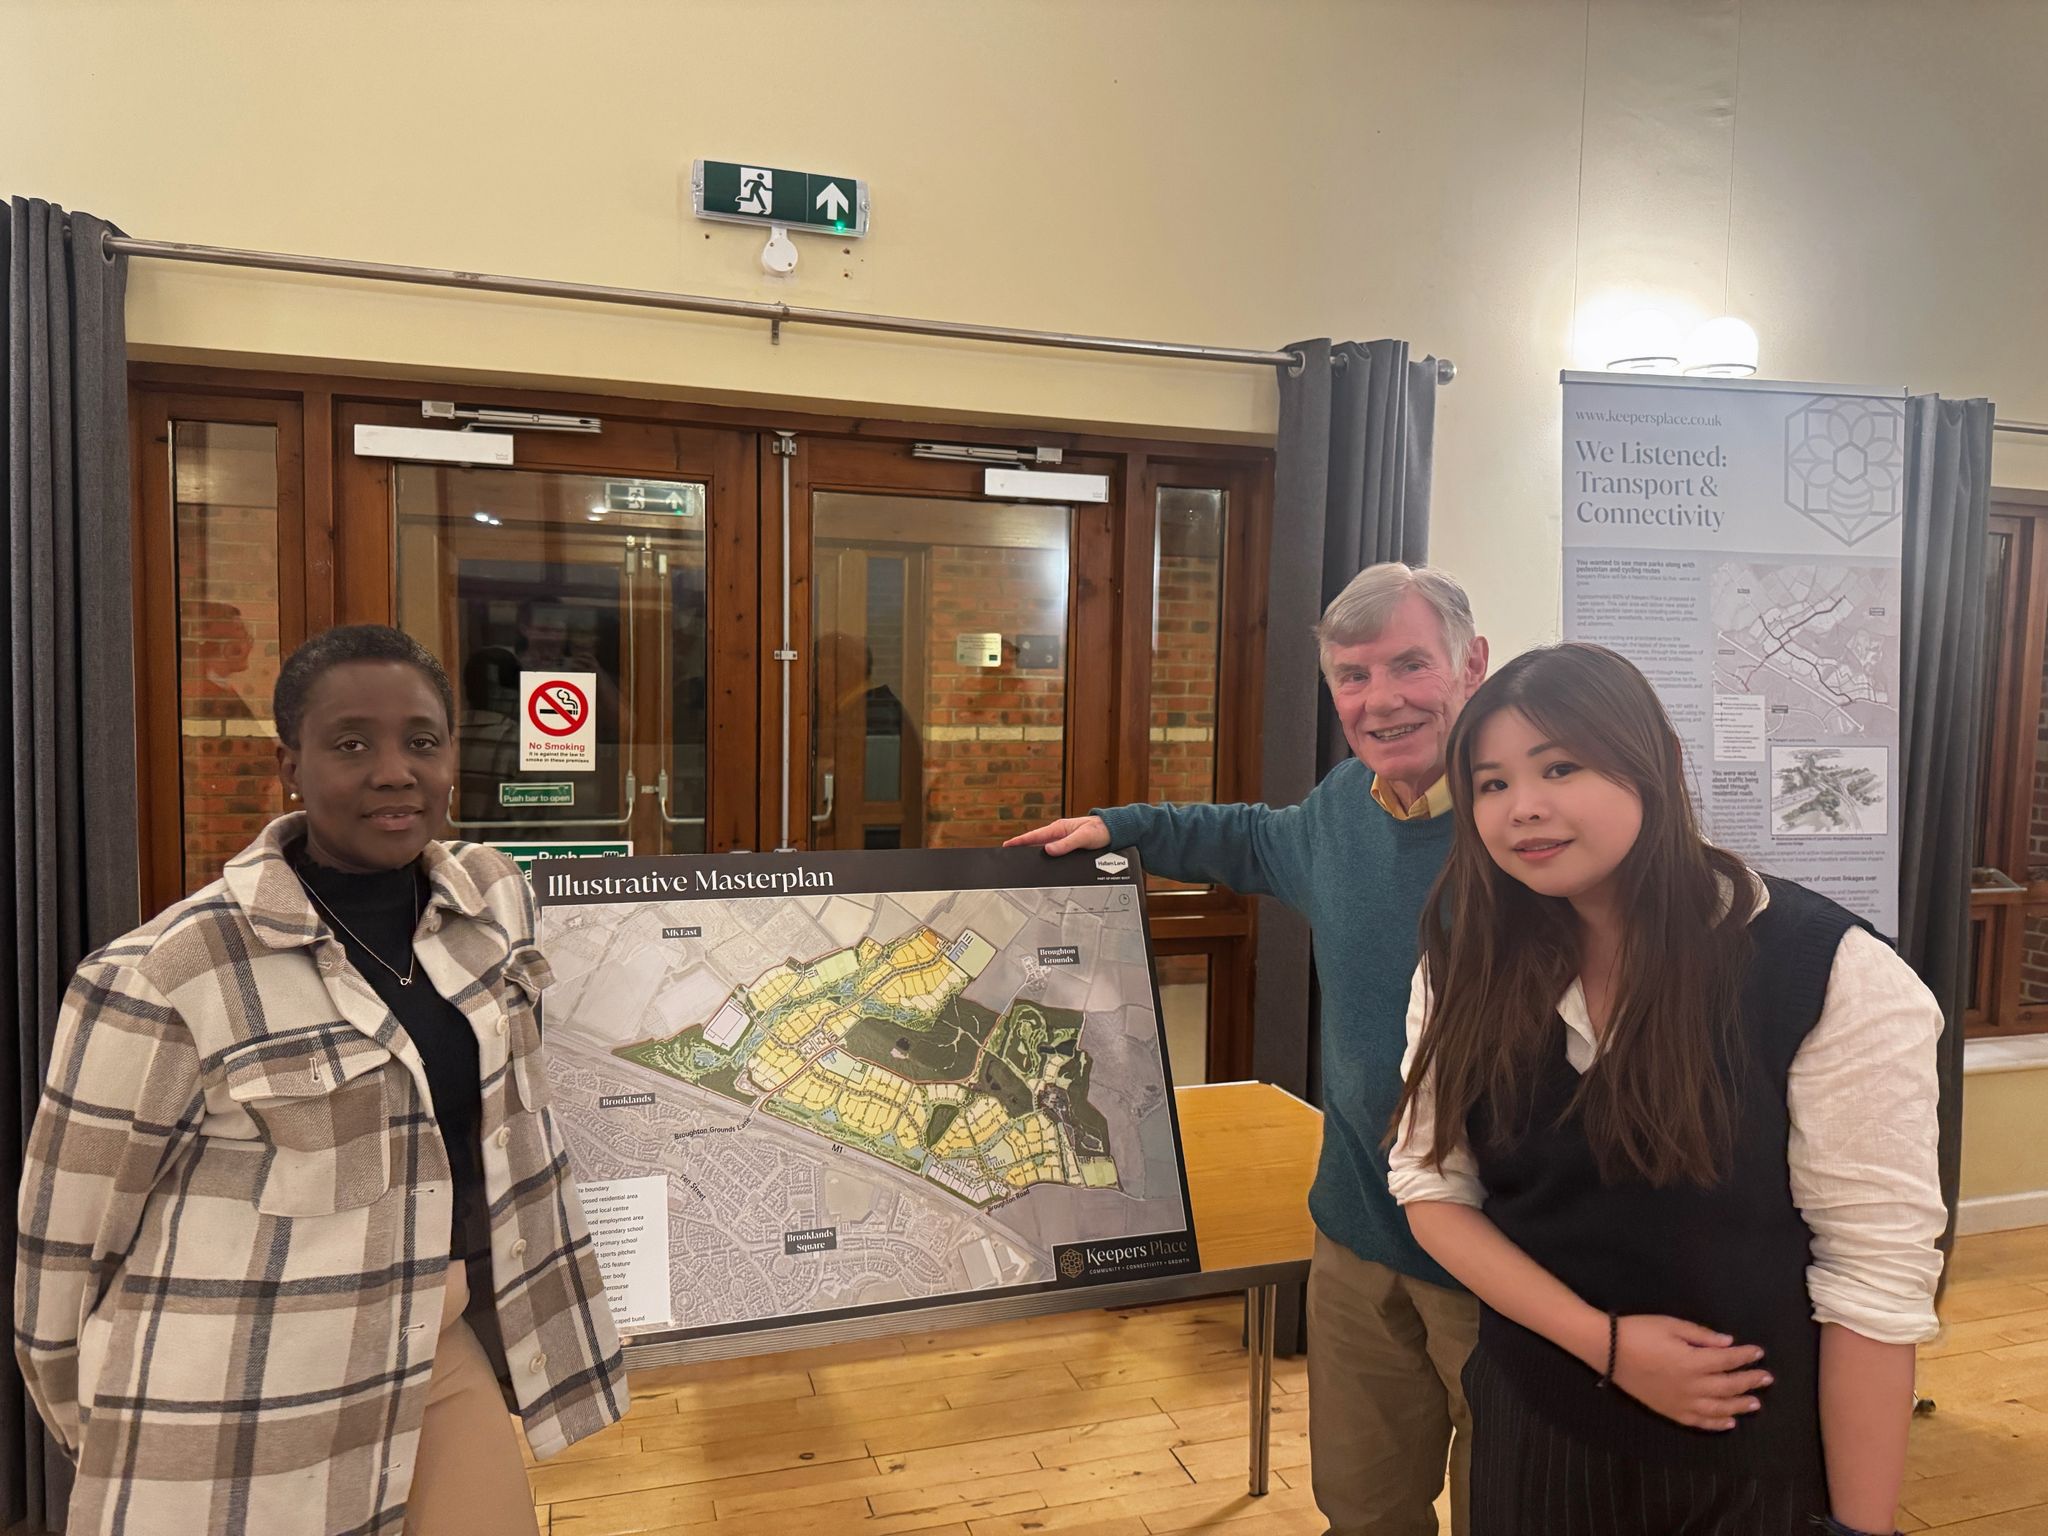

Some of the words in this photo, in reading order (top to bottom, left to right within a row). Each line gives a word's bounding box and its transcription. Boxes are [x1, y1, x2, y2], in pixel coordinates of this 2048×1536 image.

[1576, 410, 1722, 426] www.keepersplace.co.uk
[1576, 441, 1614, 462] We
[1622, 441, 1727, 467] Listened:
[1576, 471, 1694, 499] Transport
[1700, 475, 1718, 496] &
[1576, 502, 1724, 533] Connectivity
[545, 743, 585, 752] Smoking
[548, 871, 688, 896] Illustrative
[695, 866, 834, 892] Masterplan
[602, 1094, 652, 1106] Brooklands
[674, 1127, 707, 1140] Broughton
[737, 1117, 751, 1131] Lane
[832, 1144, 843, 1154] M1
[680, 1173, 691, 1185] Fen
[690, 1182, 706, 1201] Street
[600, 1216, 631, 1224] employment
[787, 1230, 833, 1242] Brooklands
[797, 1242, 825, 1252] Square
[1086, 1245, 1146, 1265] Keepers
[1150, 1240, 1187, 1256] Place
[1089, 1266, 1121, 1275] COMMUNITY
[1126, 1261, 1162, 1271] CONNECTIVITY
